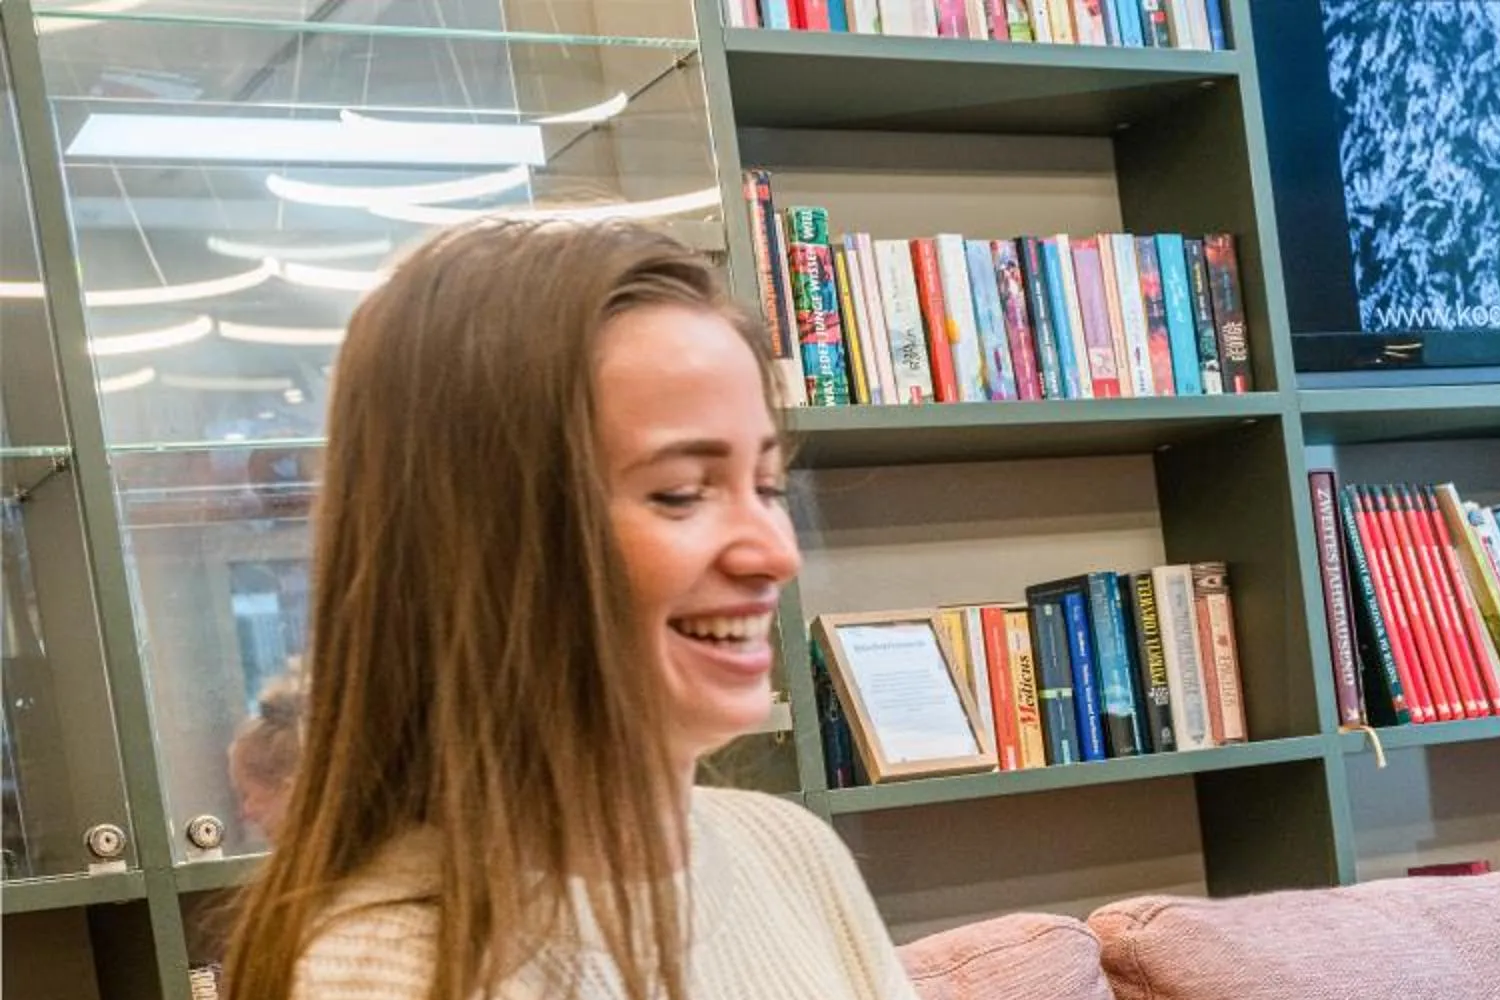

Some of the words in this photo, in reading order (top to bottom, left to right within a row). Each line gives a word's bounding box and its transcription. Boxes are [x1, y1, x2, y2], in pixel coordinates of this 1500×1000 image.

[811, 296, 826, 339] JUNGE
[823, 376, 836, 406] WAS
[1317, 487, 1339, 563] ZWEITES
[1325, 565, 1356, 688] JAHRTAUSEND
[1017, 654, 1039, 727] Medicus
